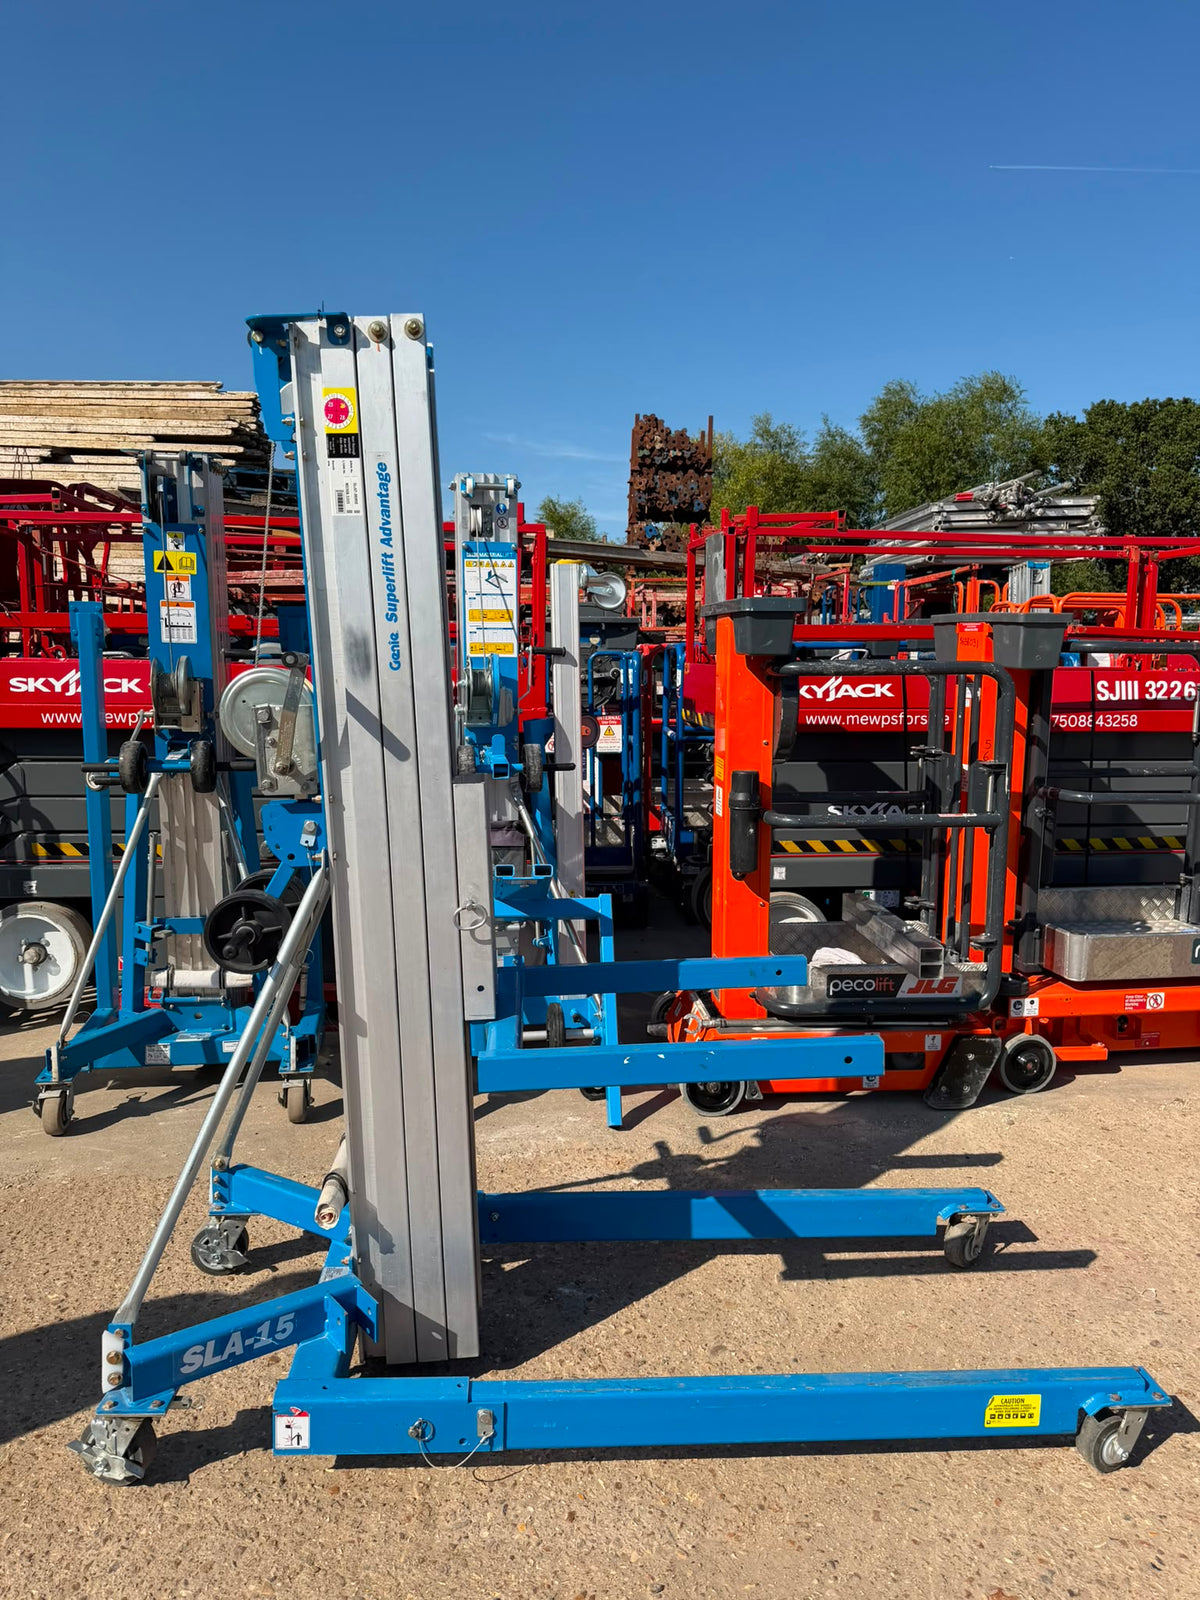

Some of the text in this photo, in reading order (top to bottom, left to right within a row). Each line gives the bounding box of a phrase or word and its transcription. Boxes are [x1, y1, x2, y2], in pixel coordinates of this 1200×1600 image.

[375, 461, 402, 672] Genie Superlift Advantage
[9, 668, 143, 696] SKYJCK
[799, 675, 895, 702] KYJACK
[1096, 680, 1196, 701] SJIII 3226
[1051, 714, 1138, 728] 7508843258
[829, 976, 960, 996] pecolift JLG
[179, 1312, 296, 1374] SLA-15
